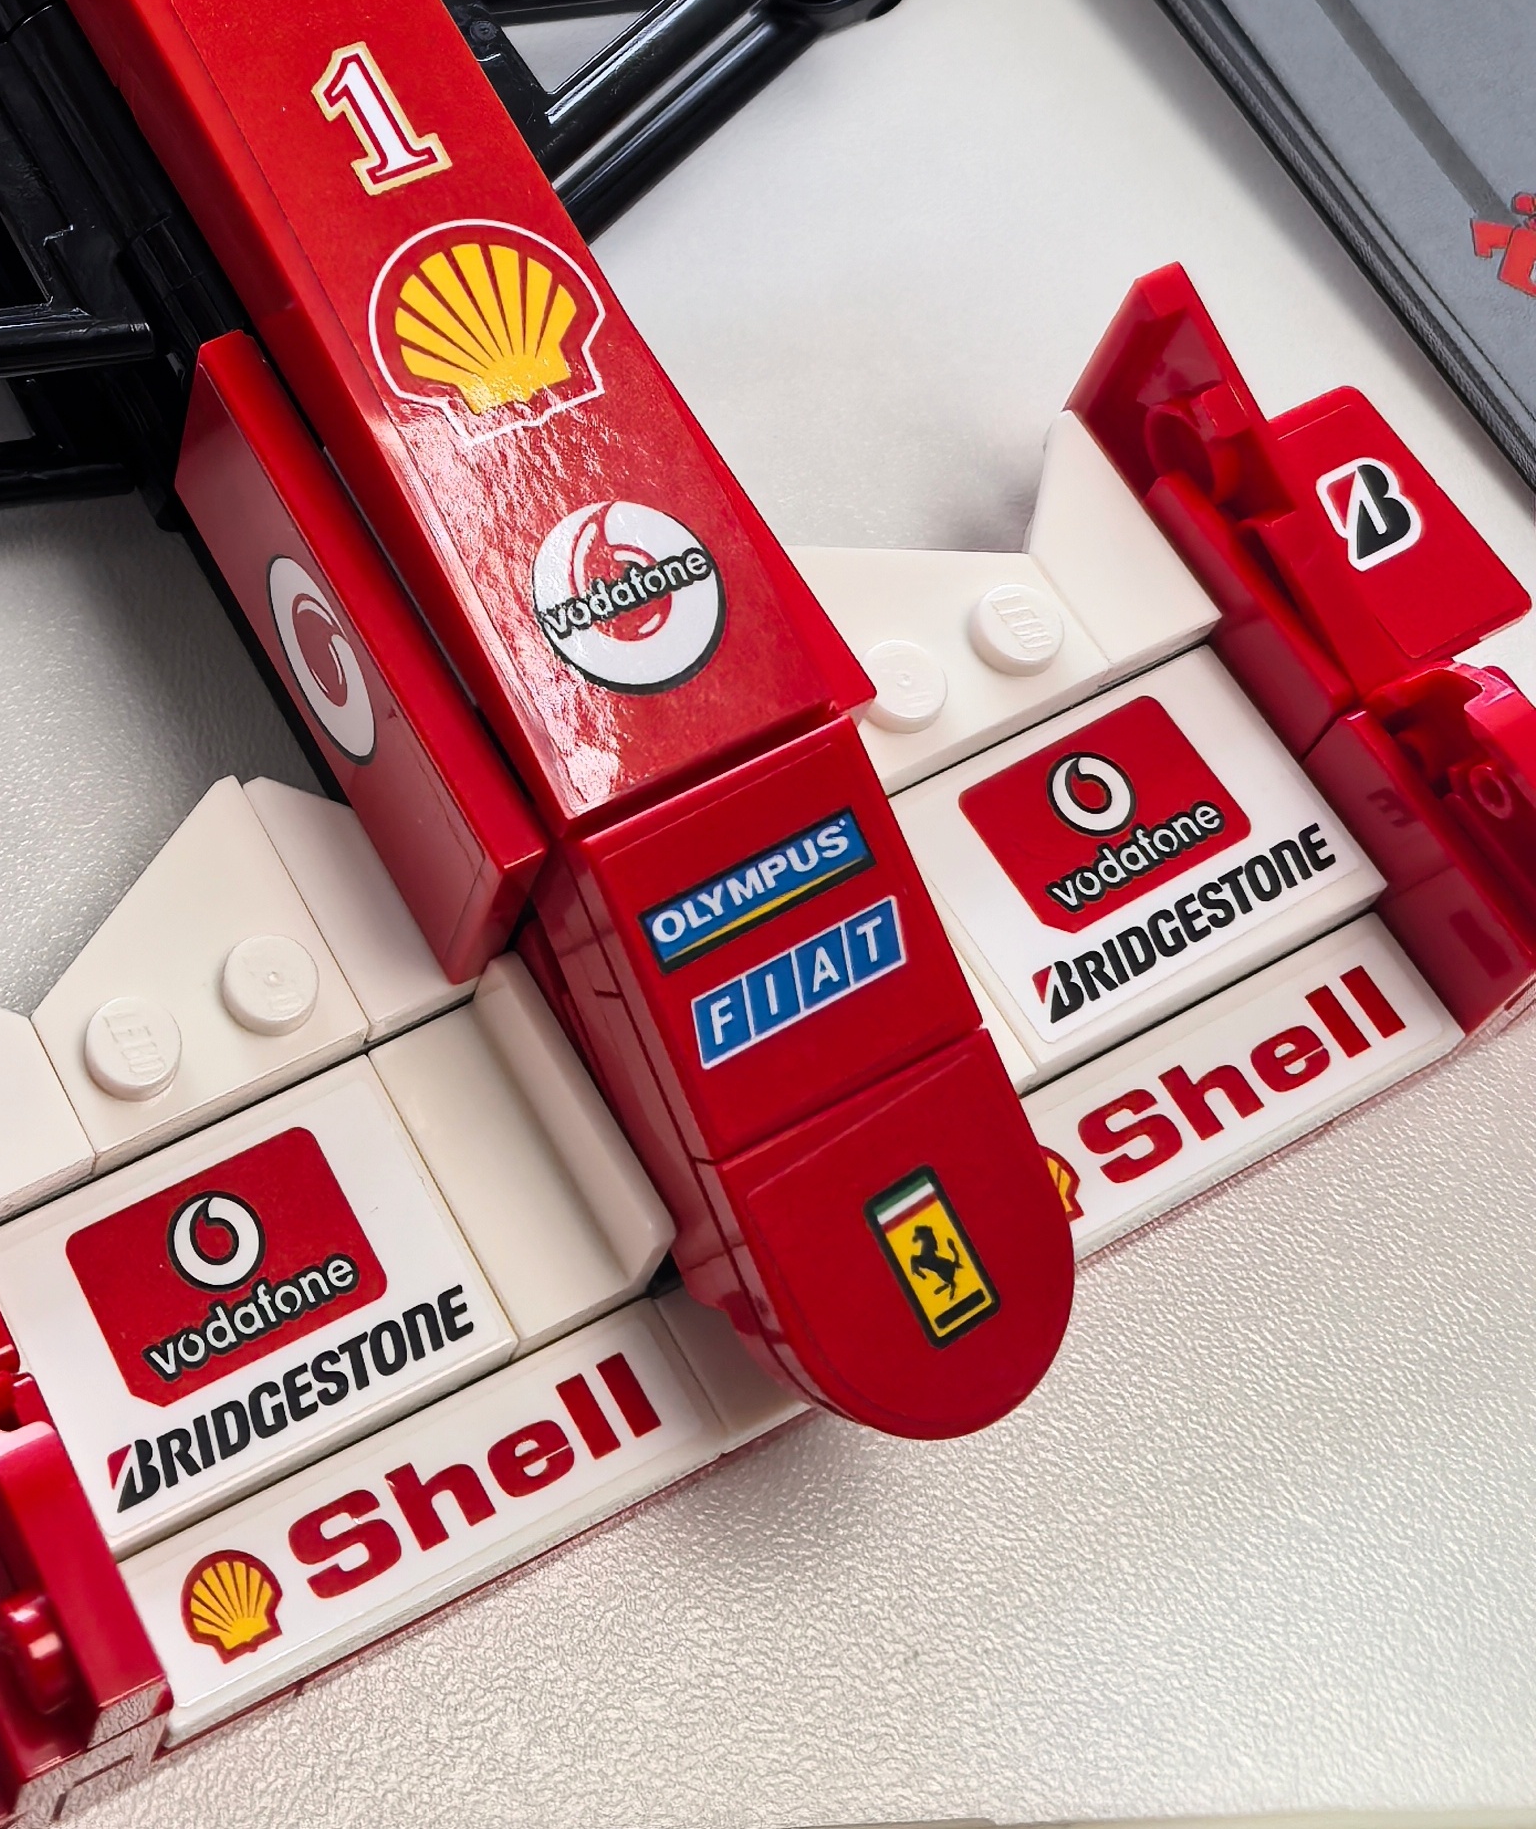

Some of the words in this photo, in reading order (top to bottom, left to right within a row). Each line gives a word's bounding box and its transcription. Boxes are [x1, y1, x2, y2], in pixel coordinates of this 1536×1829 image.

[310, 41, 453, 196] 1
[542, 548, 713, 639] vodafone
[650, 822, 849, 945] OLYMPUS
[1034, 822, 1335, 1023] BRIDGESTONE
[1047, 800, 1224, 914] vodafone
[702, 909, 890, 1051] FIAT
[1079, 966, 1405, 1184] Shell
[142, 1253, 359, 1380] vodafone
[108, 1285, 473, 1512] BRIDGESTONE
[288, 1353, 662, 1599] Shell
